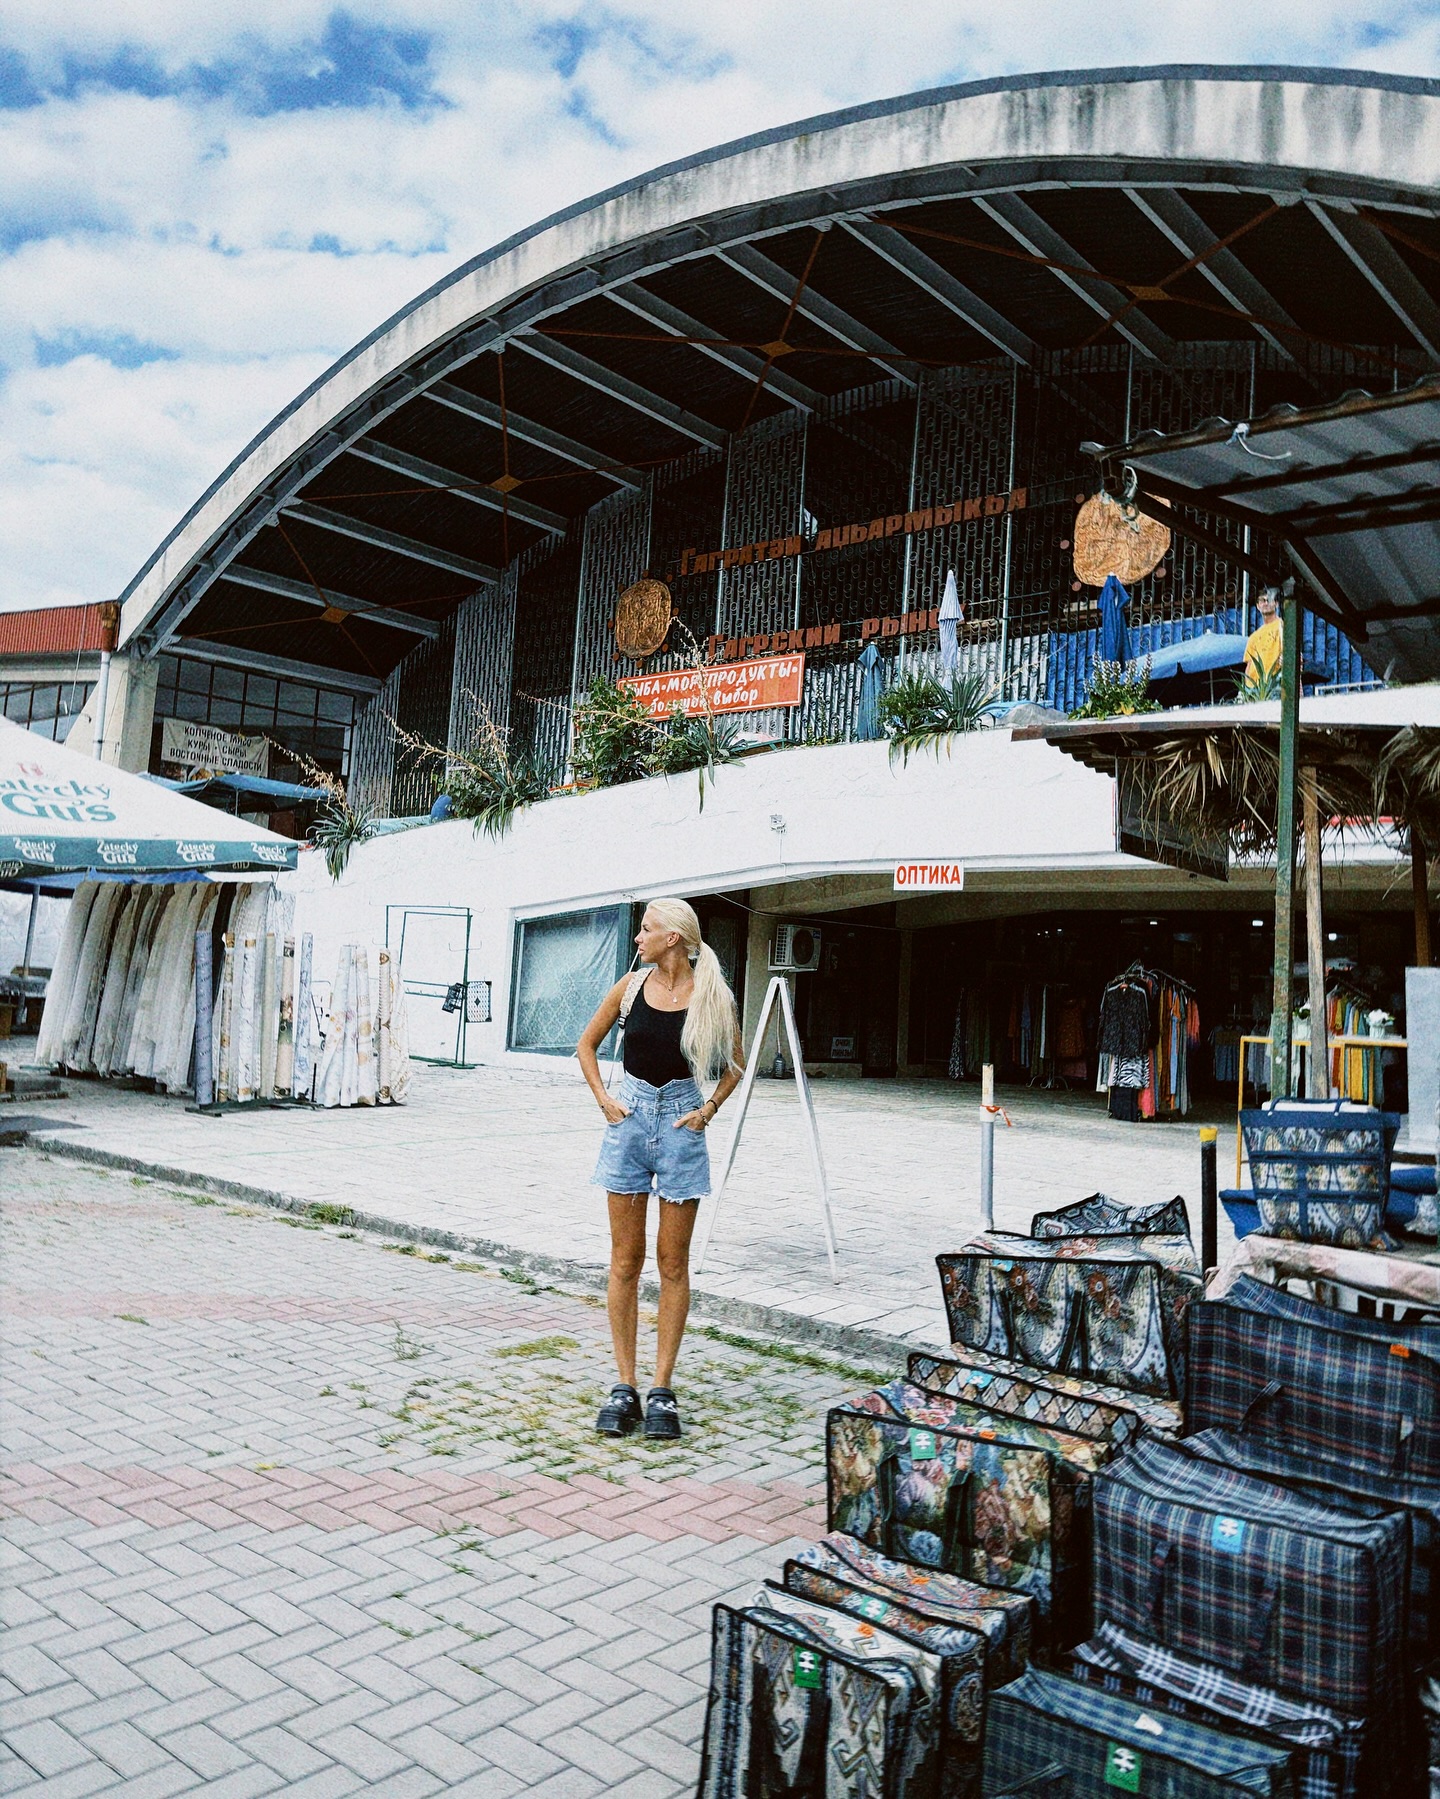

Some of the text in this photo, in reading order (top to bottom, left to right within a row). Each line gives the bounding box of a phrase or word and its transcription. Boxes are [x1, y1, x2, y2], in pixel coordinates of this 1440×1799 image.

[187, 739, 247, 758] КУРЫ СЫРЫ
[170, 748, 262, 772] ВОСТОЧНЫЕ СЛАДОСТИ
[896, 865, 961, 885] ОПТИКА
